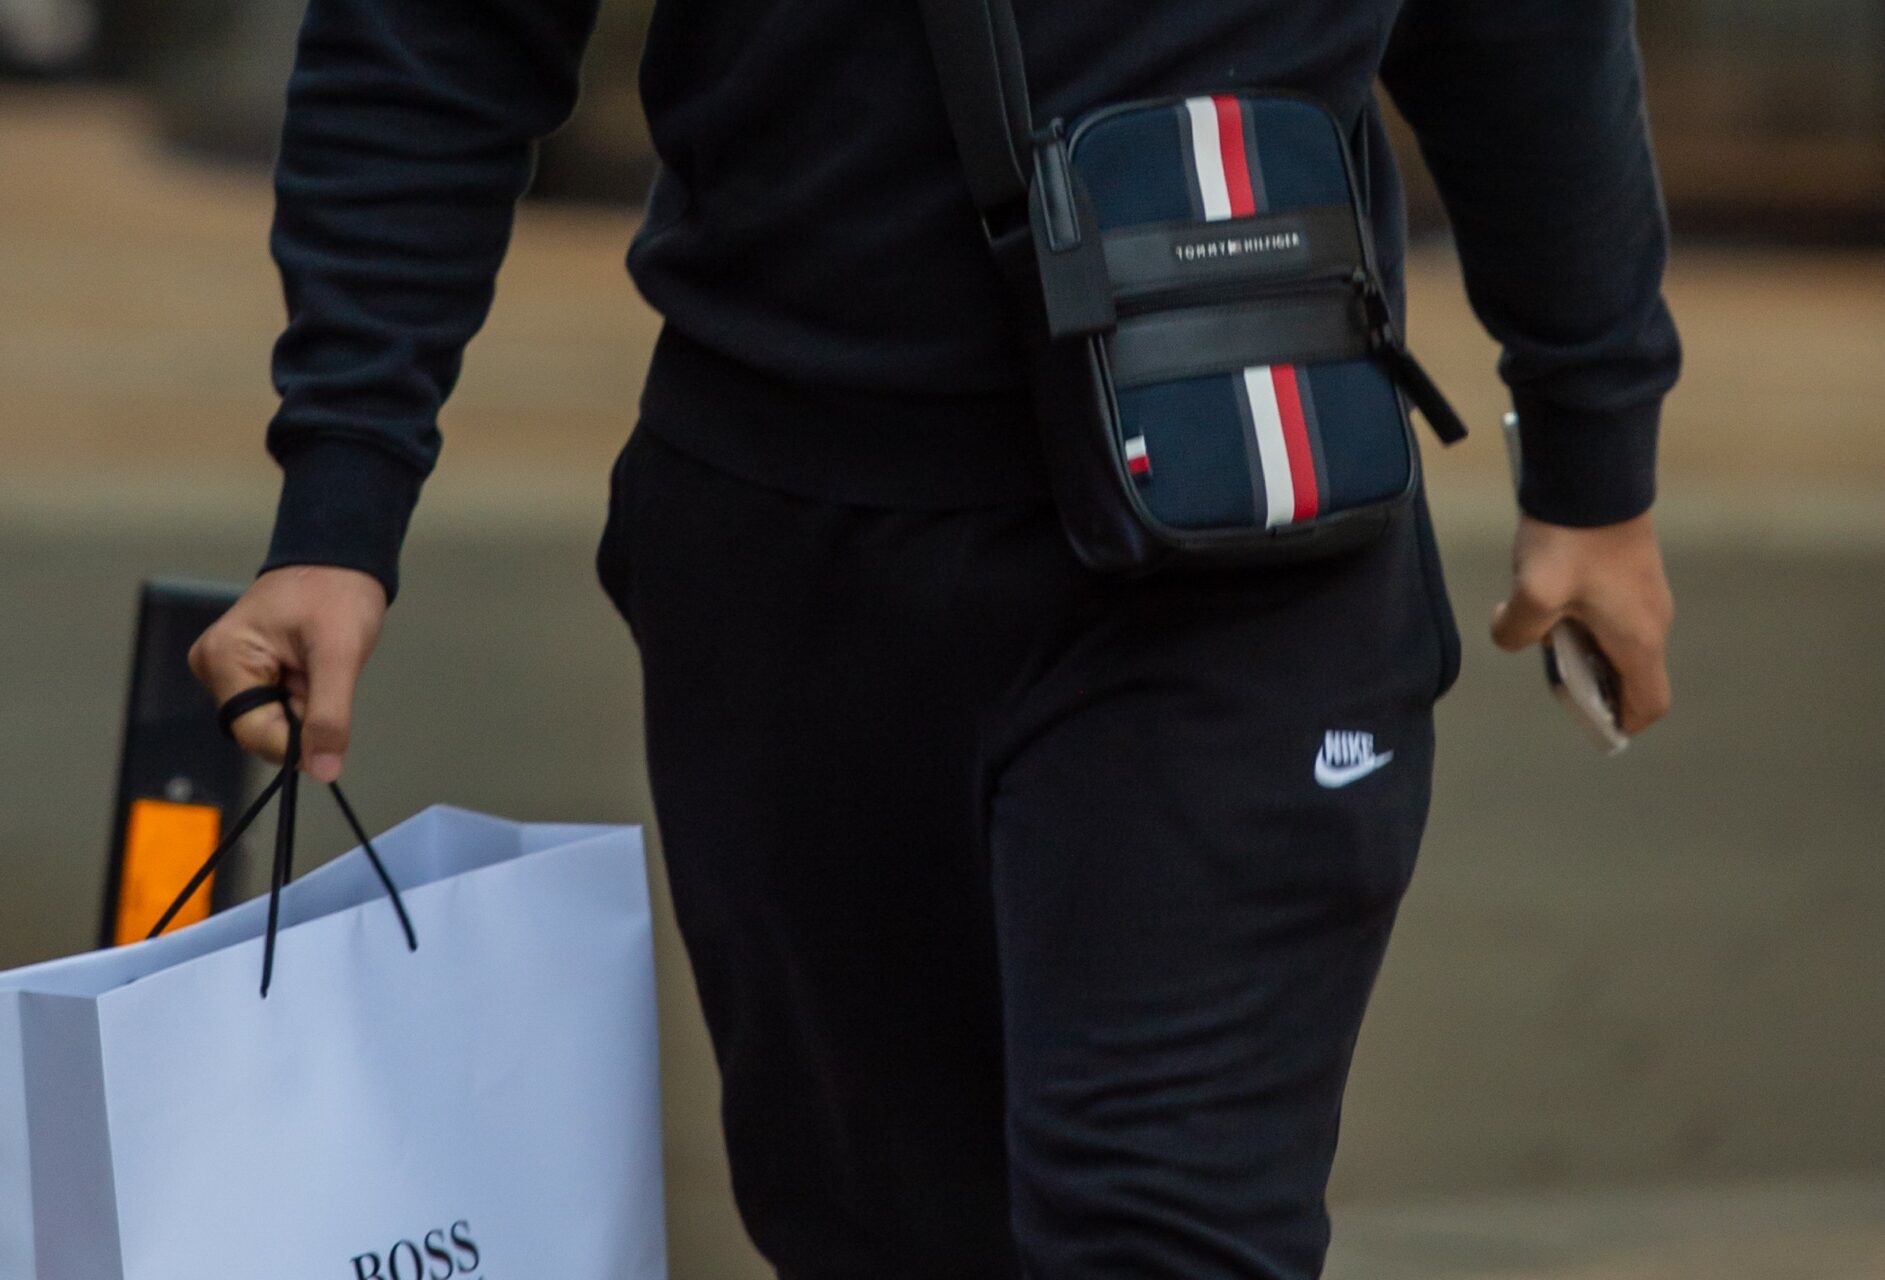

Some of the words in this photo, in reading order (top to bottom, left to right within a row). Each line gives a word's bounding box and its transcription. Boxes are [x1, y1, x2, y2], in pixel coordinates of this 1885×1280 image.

[1176, 242, 1226, 260] TOMMY
[1244, 232, 1300, 253] HILFIGER
[1325, 729, 1376, 767] NIKE
